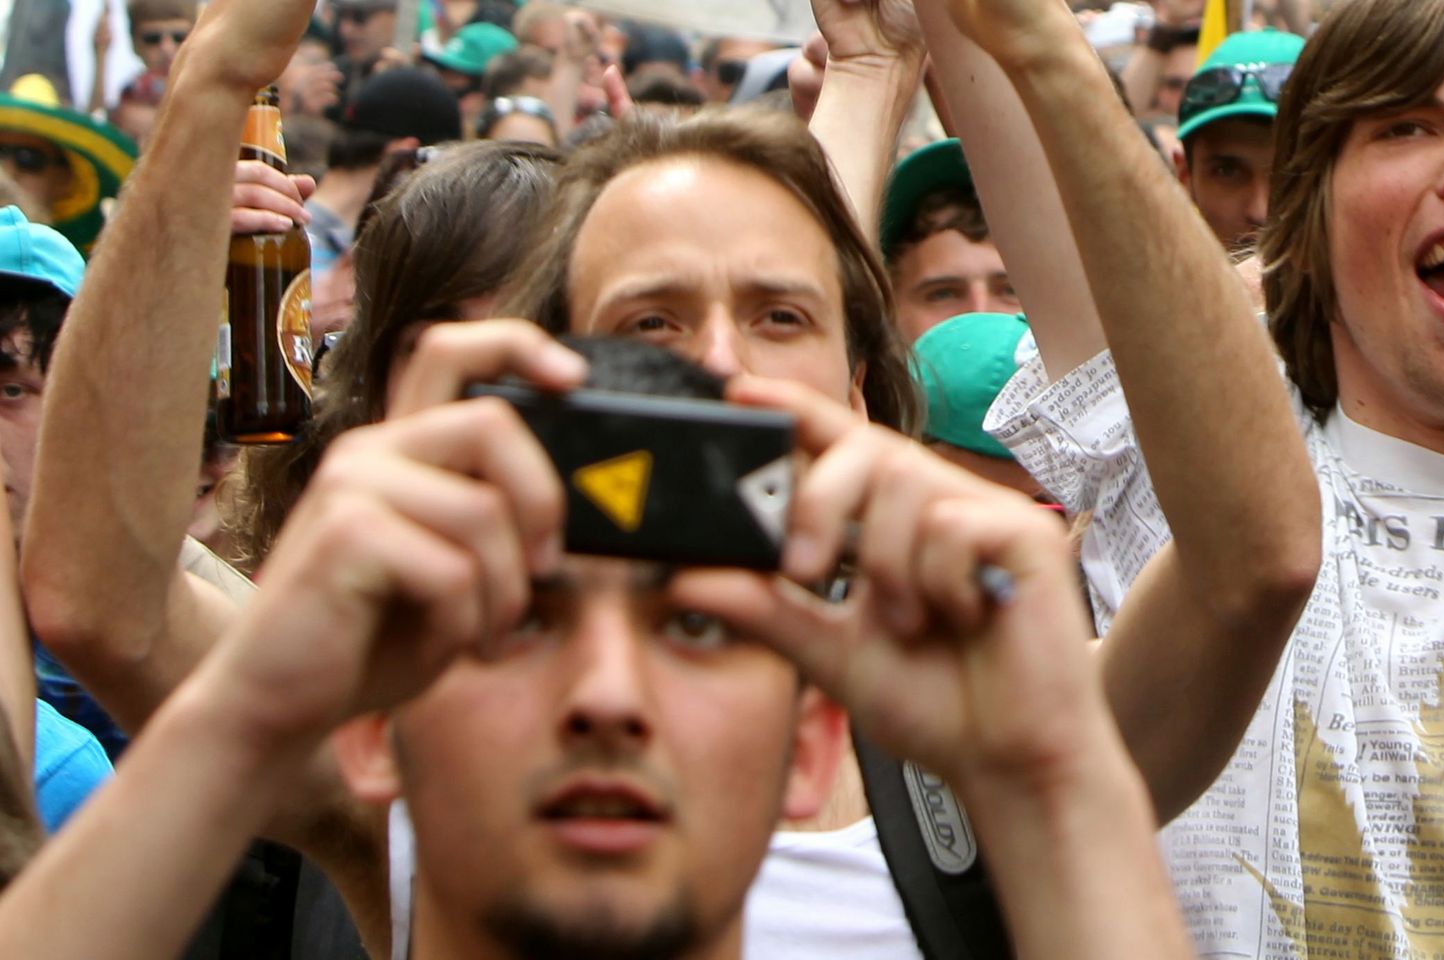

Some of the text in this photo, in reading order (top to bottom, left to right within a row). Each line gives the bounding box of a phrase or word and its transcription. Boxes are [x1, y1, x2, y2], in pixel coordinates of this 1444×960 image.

[1322, 743, 1345, 755] This
[1370, 740, 1413, 753] Young
[1372, 773, 1391, 783] be
[1215, 823, 1260, 837] estimated
